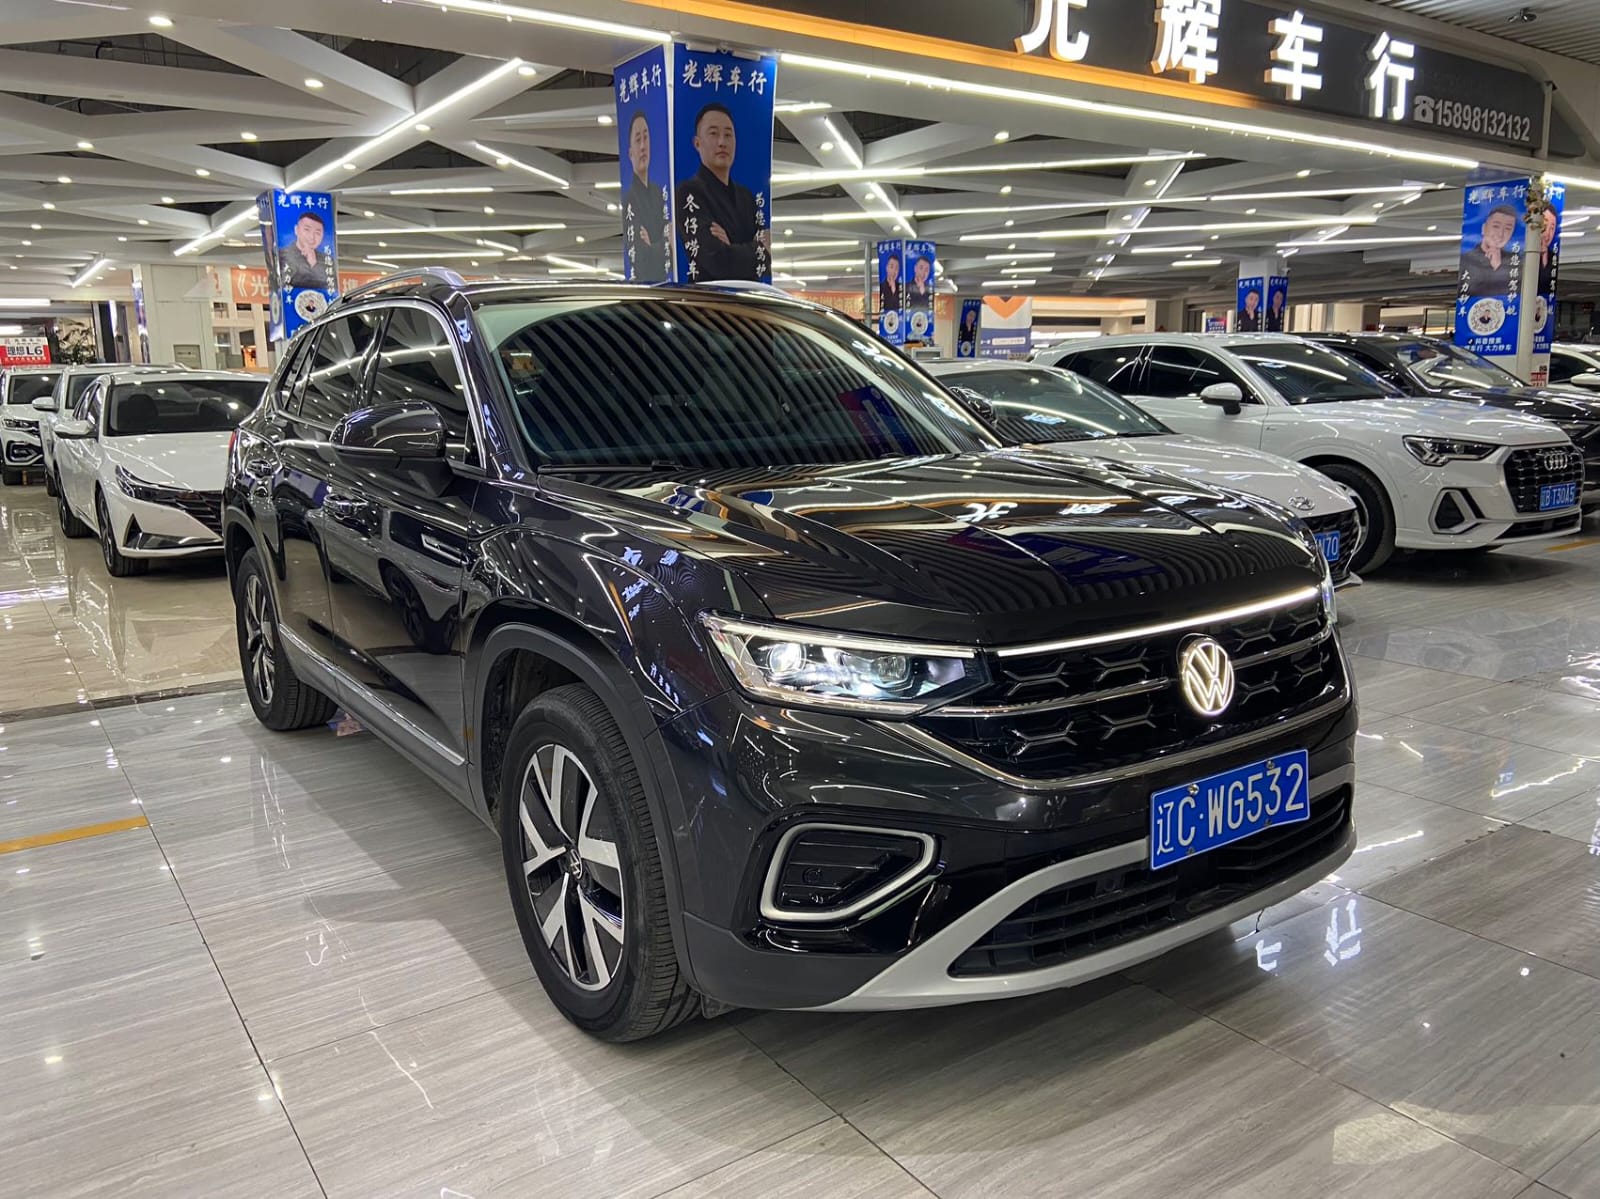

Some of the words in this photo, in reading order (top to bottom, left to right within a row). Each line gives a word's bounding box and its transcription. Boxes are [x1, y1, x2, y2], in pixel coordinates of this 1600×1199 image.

[619, 63, 662, 103] 光辉车行
[682, 59, 768, 95] 光辉车行
[1434, 99, 1531, 142] 15898132132
[277, 194, 329, 210] 光辉车行
[1467, 185, 1526, 205] 光辉车行
[1157, 763, 1304, 855] 辽C·WG532
